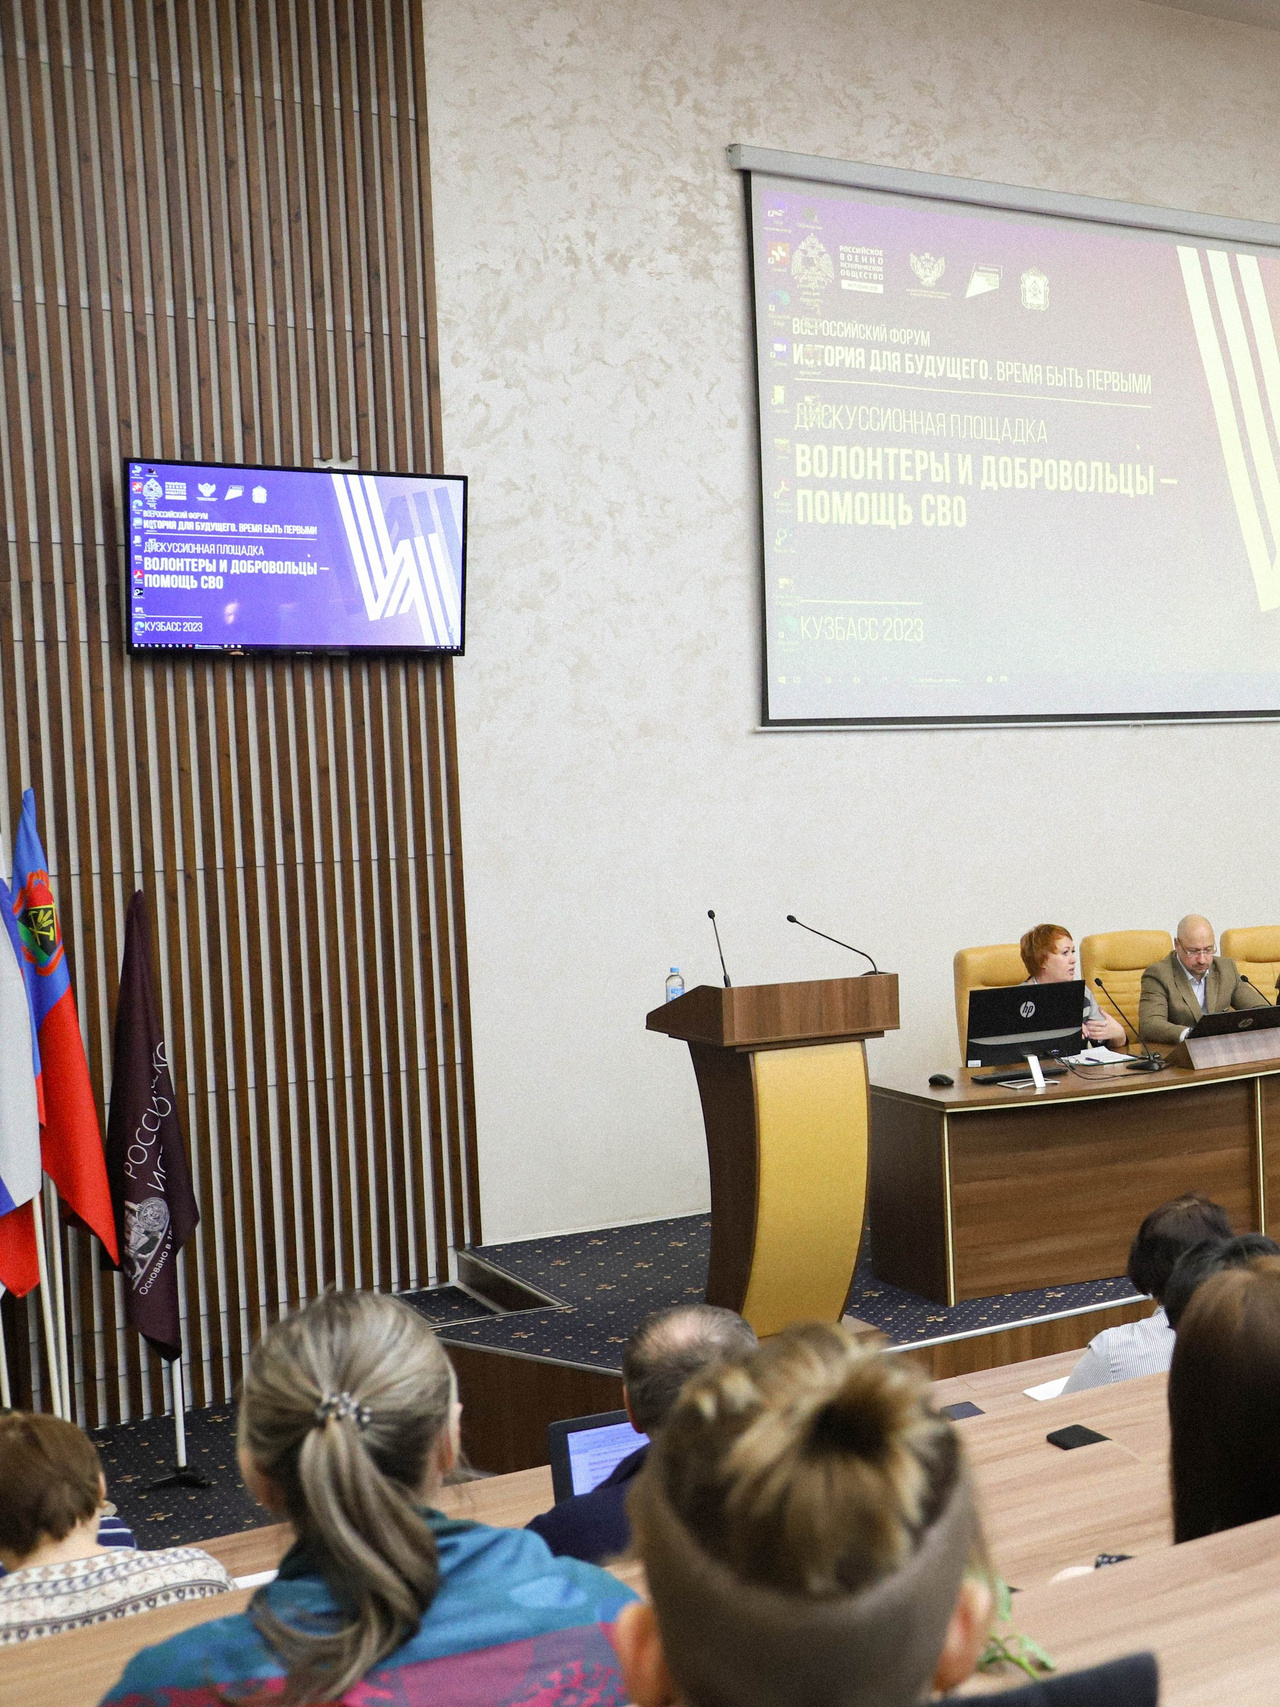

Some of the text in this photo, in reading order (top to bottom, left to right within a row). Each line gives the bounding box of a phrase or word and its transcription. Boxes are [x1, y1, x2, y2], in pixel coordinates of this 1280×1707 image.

[839, 245, 884, 256] РОССИЙСКОЕ
[839, 253, 884, 265] ВОЕННО
[840, 269, 884, 281] ОБЩЕСТВО
[792, 318, 888, 343] ВСЕРОССИЙСКИЙ
[889, 327, 931, 347] ФОРУМ
[793, 343, 1152, 395] ИСТОРИЯ ДЛЯ БУДУЩЕГО. ВРЕМЯ БЫТЬ ПЕРВЫМИ
[795, 403, 1048, 446] ДИСКУССИОННАЯ ПЛОЩАДКА
[795, 443, 951, 484] ВОЛОНТЕРЫ
[957, 453, 974, 486] И
[980, 454, 1155, 499] ДОБРОВОЛЬЦЫ
[796, 489, 968, 530] ПОМОЩЬ СВО
[177, 520, 195, 531] ДЛЯ
[195, 521, 238, 533] БУДУЩЕГО.
[238, 523, 263, 533] ВРЕМЯ
[263, 524, 283, 534] БЫТЬ
[283, 525, 318, 535] ПЕРВЫМИ
[216, 544, 265, 556] ПЛОЩАДКА
[143, 557, 217, 573] ВОЛОНТЕРЫ
[219, 559, 228, 573] И
[230, 559, 318, 577] ДОБРОВОЛЬЦЫ
[144, 574, 224, 590] ПОМОЩЬ СВО
[144, 621, 203, 632] КУЗБАСС 2023
[800, 615, 925, 643] КУЗБАСС 2023
[1021, 1001, 1036, 1018] hp
[138, 1251, 169, 1295] Основано
